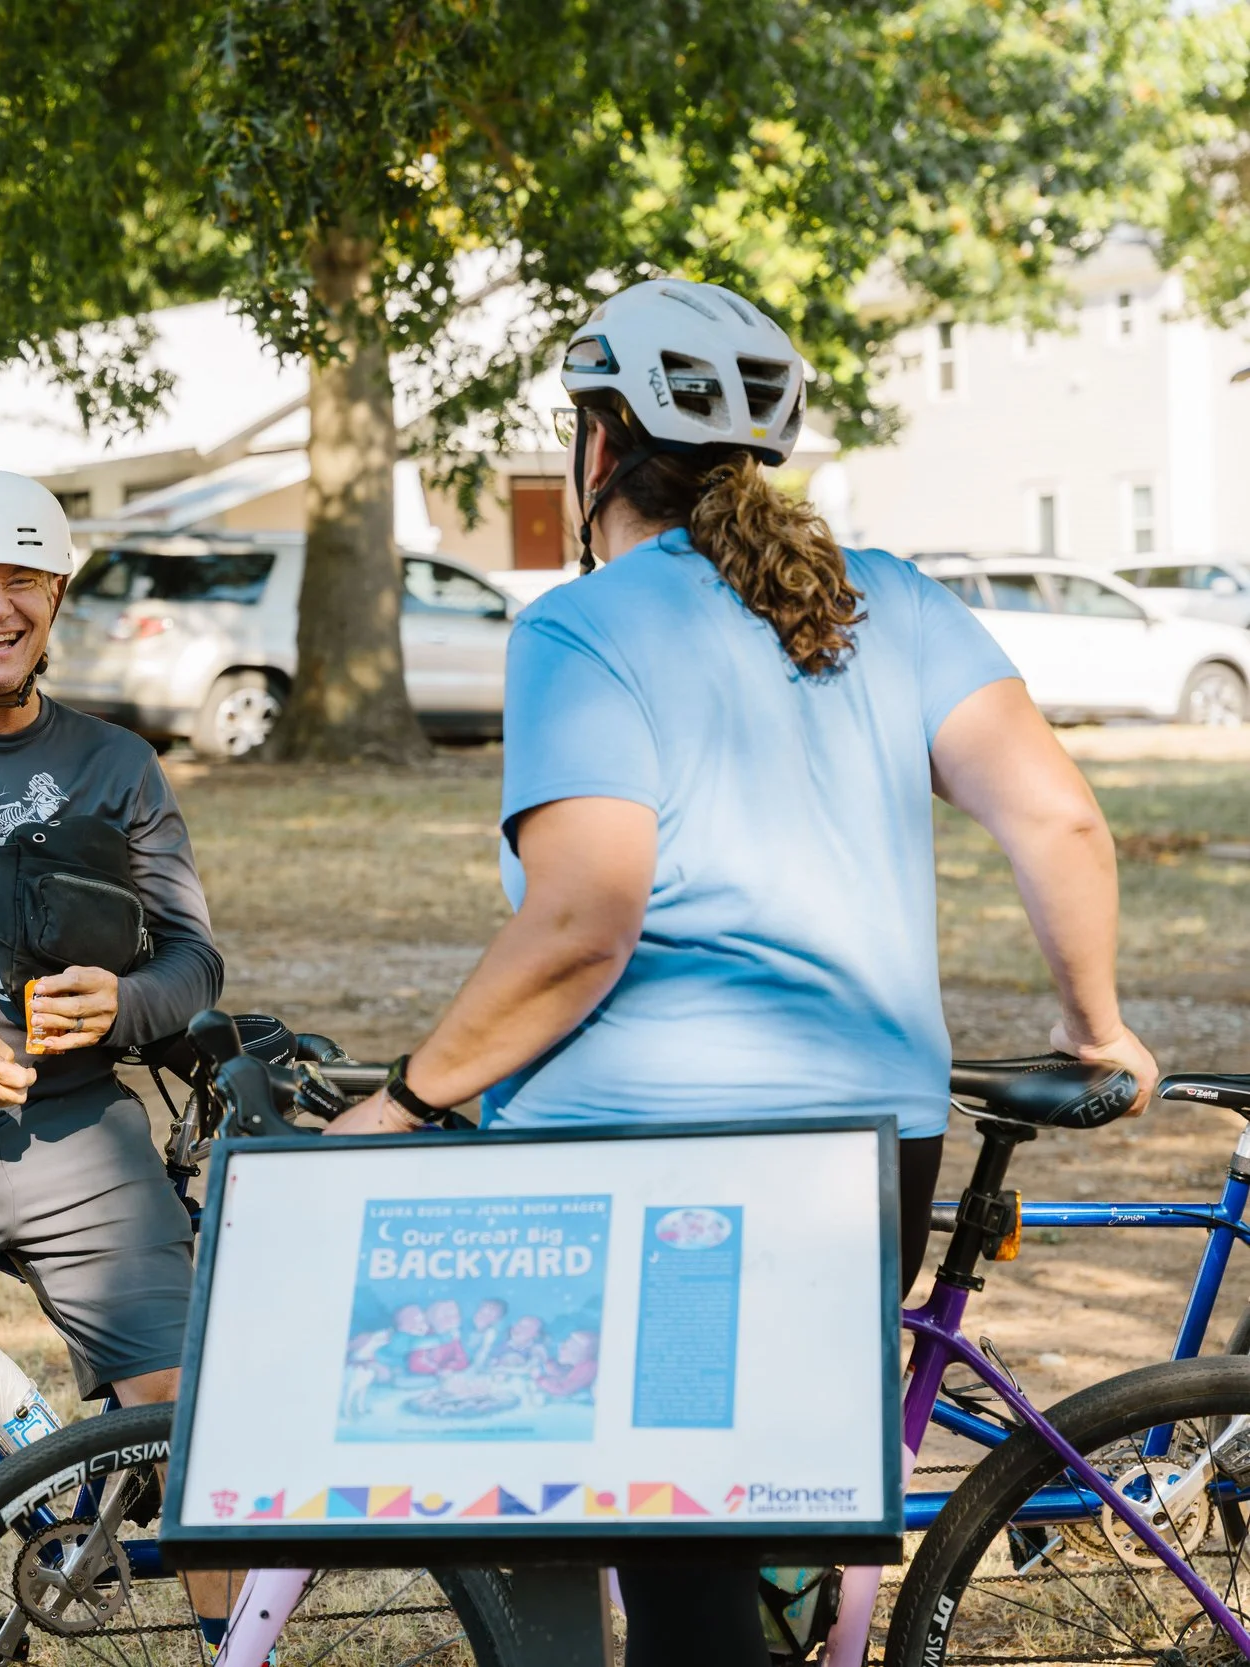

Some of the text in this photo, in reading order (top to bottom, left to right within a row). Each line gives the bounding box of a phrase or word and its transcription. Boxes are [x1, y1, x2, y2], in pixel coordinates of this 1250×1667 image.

[1071, 1075, 1135, 1126] TERRY
[369, 1206, 413, 1218] LAURA
[417, 1205, 451, 1217] BUSH
[476, 1203, 519, 1217] JENNA
[522, 1203, 558, 1215] BUSH
[561, 1201, 607, 1214] HAGER
[402, 1225, 564, 1247] Our Great Big
[368, 1246, 593, 1281] BACKYARD
[749, 1483, 858, 1502] Pioneer
[923, 1594, 956, 1667] DT SW
